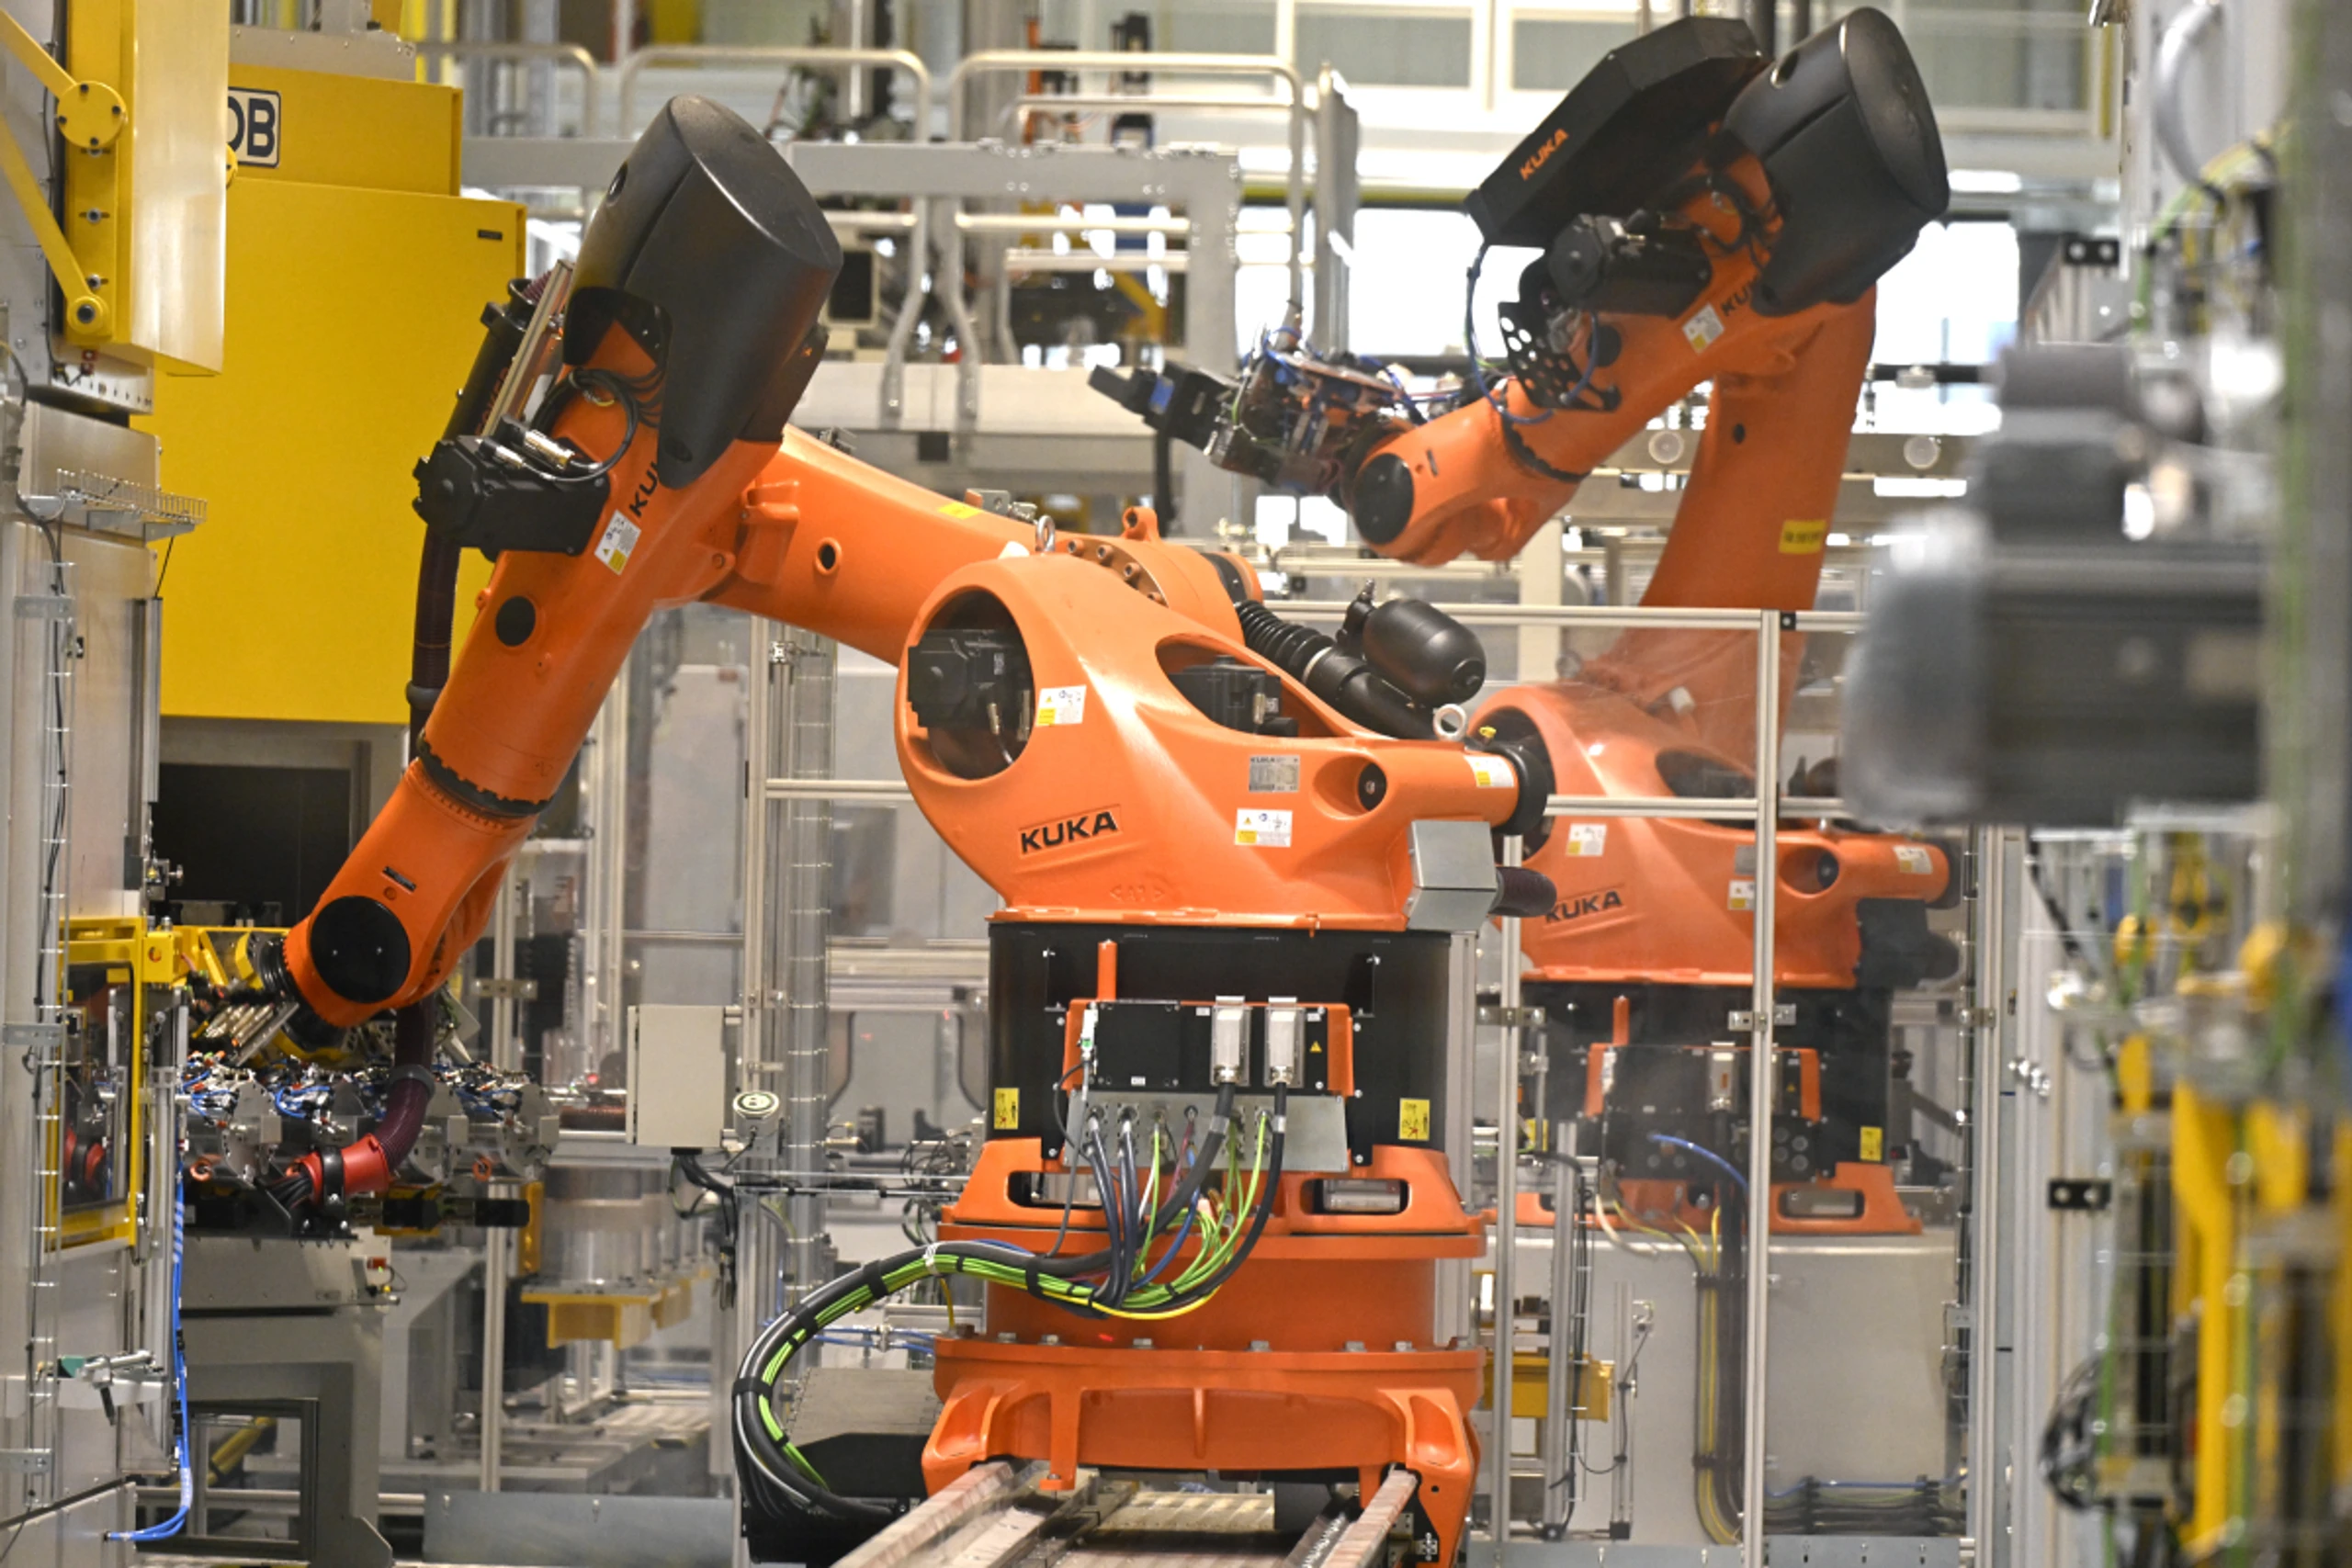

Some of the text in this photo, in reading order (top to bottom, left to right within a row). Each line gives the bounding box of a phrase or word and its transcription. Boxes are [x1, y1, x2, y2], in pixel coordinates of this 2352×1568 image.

[1519, 129, 1568, 181] KUKA
[628, 461, 659, 517] KU
[1021, 811, 1118, 854] KUKA
[1545, 890, 1623, 923] KUKA
